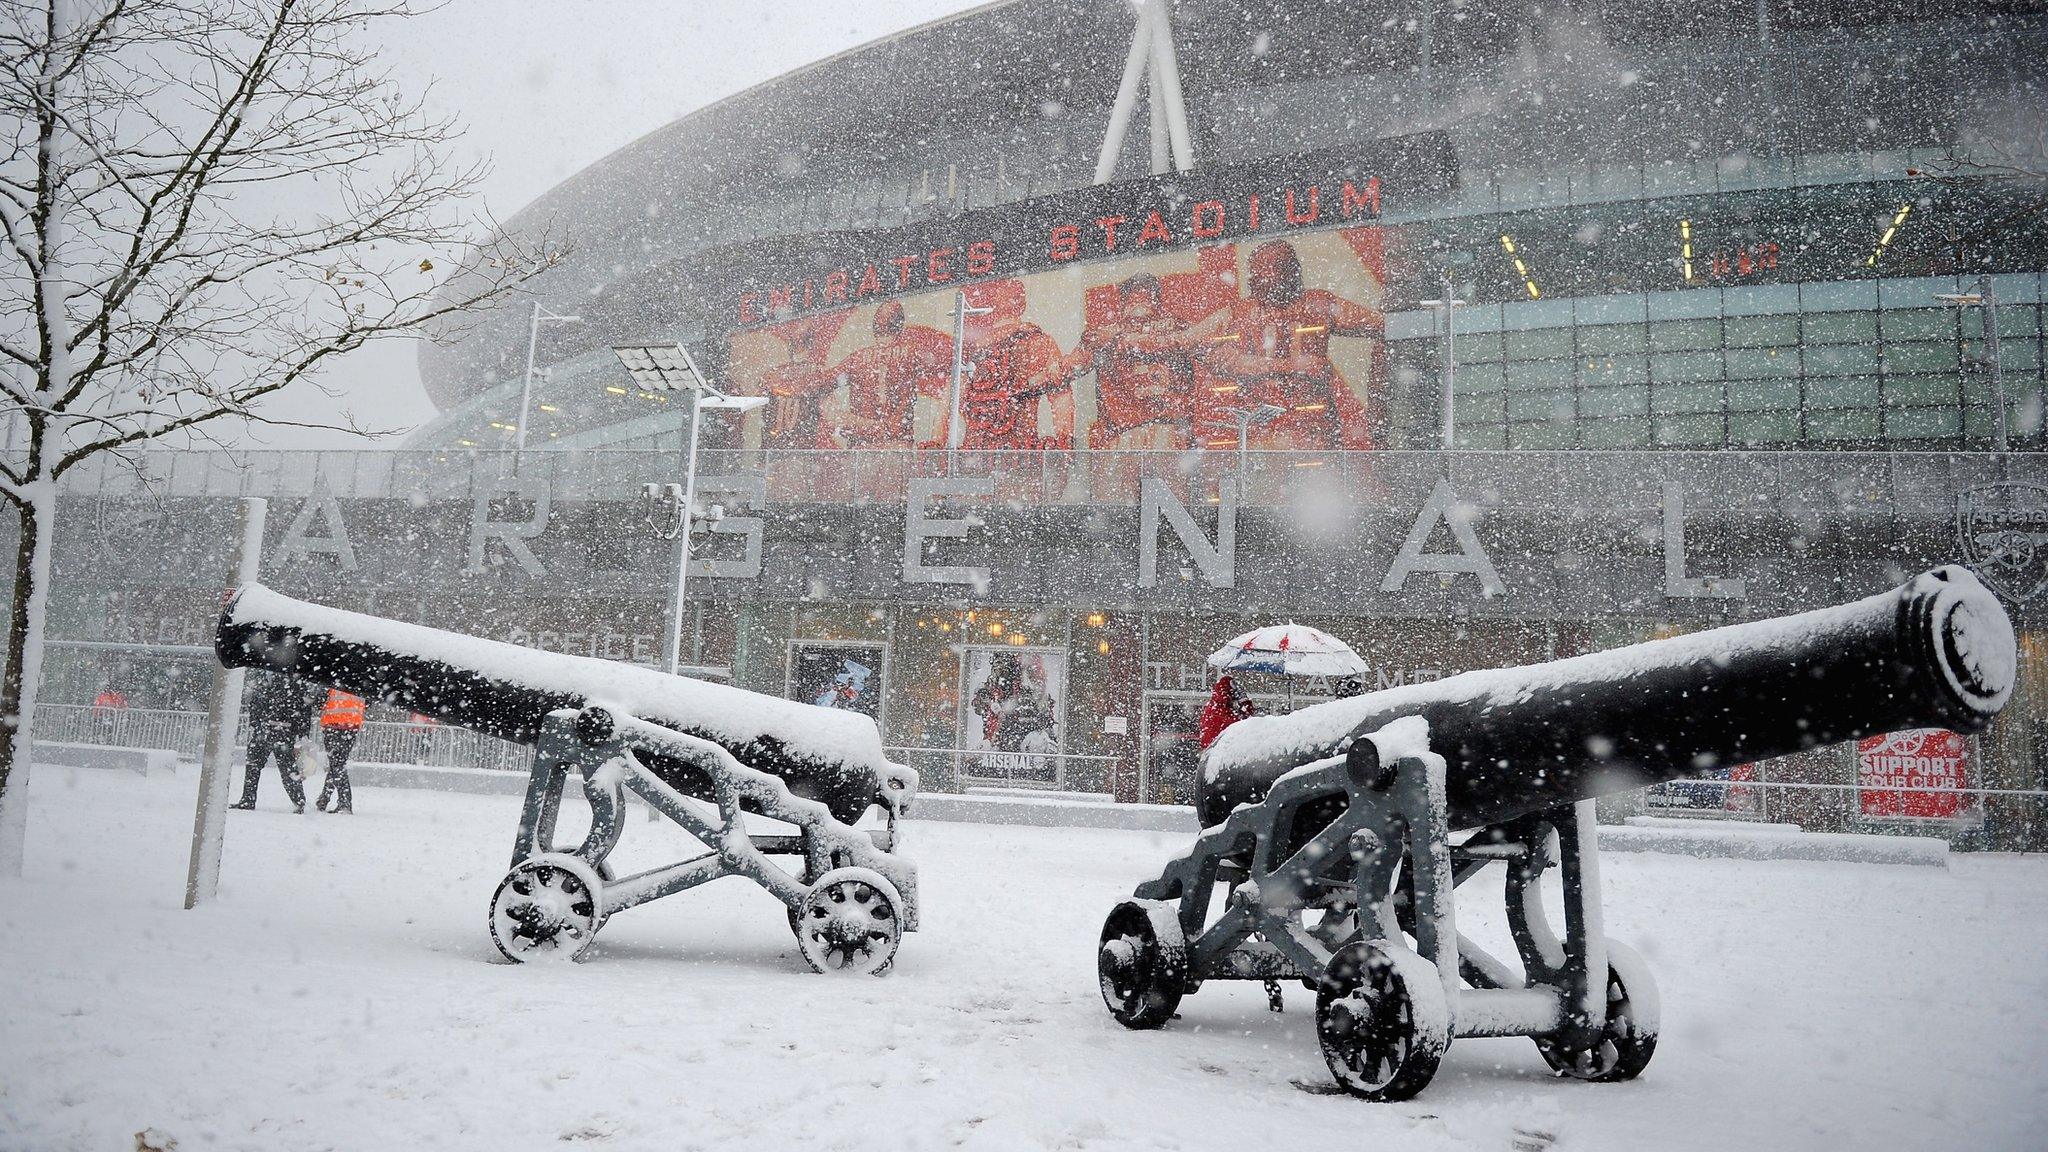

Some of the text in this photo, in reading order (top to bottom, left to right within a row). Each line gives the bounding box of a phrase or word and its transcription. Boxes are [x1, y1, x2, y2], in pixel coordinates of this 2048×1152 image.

[738, 177, 1381, 325] EMIRATES STADIUM
[265, 472, 1746, 598] ARSENAL
[1145, 661, 1222, 689] TH
[981, 752, 1031, 770] ARSENAL
[1859, 754, 1958, 776] SUPPORT
[1859, 775, 1956, 790] YOUR CLUB
